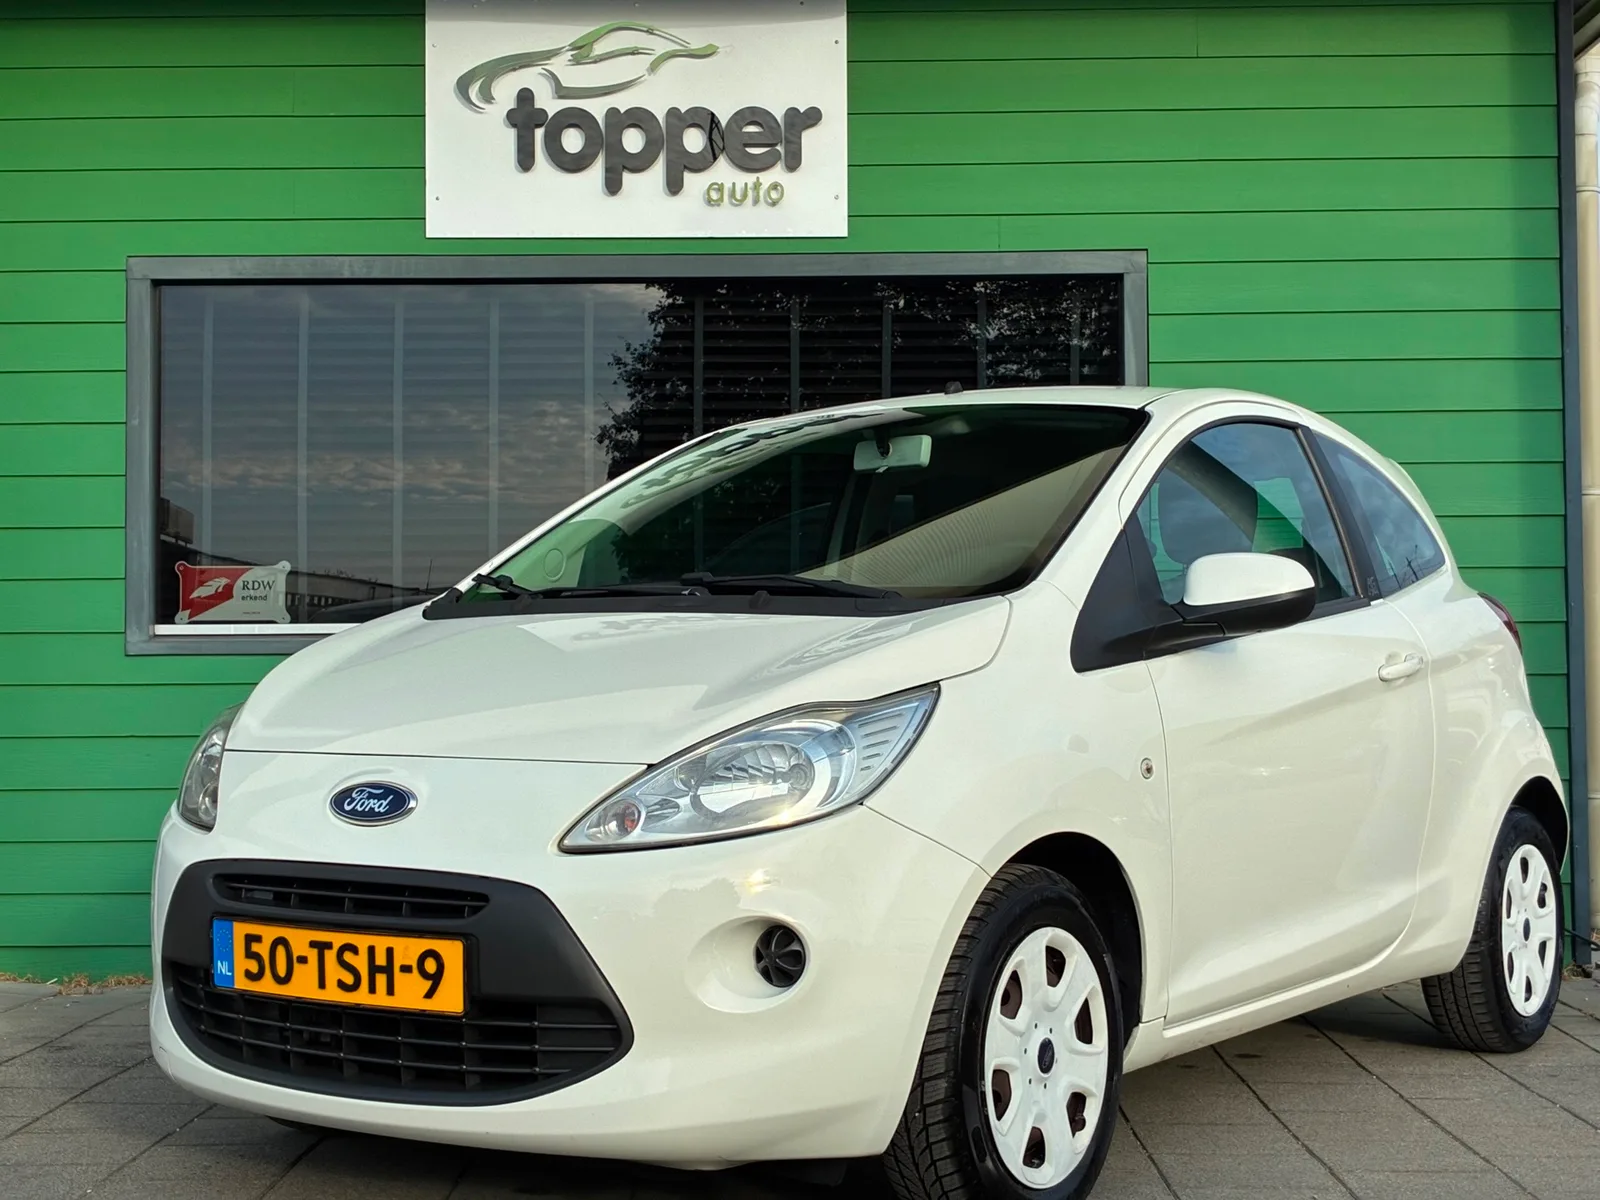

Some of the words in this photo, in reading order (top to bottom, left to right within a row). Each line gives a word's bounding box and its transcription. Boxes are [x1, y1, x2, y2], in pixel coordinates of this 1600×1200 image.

[505, 87, 823, 196] topper
[705, 177, 785, 206] auto
[242, 580, 275, 591] RDW
[343, 787, 393, 813] Ford
[217, 960, 232, 976] NL
[243, 932, 445, 1000] 50-TSH-9
